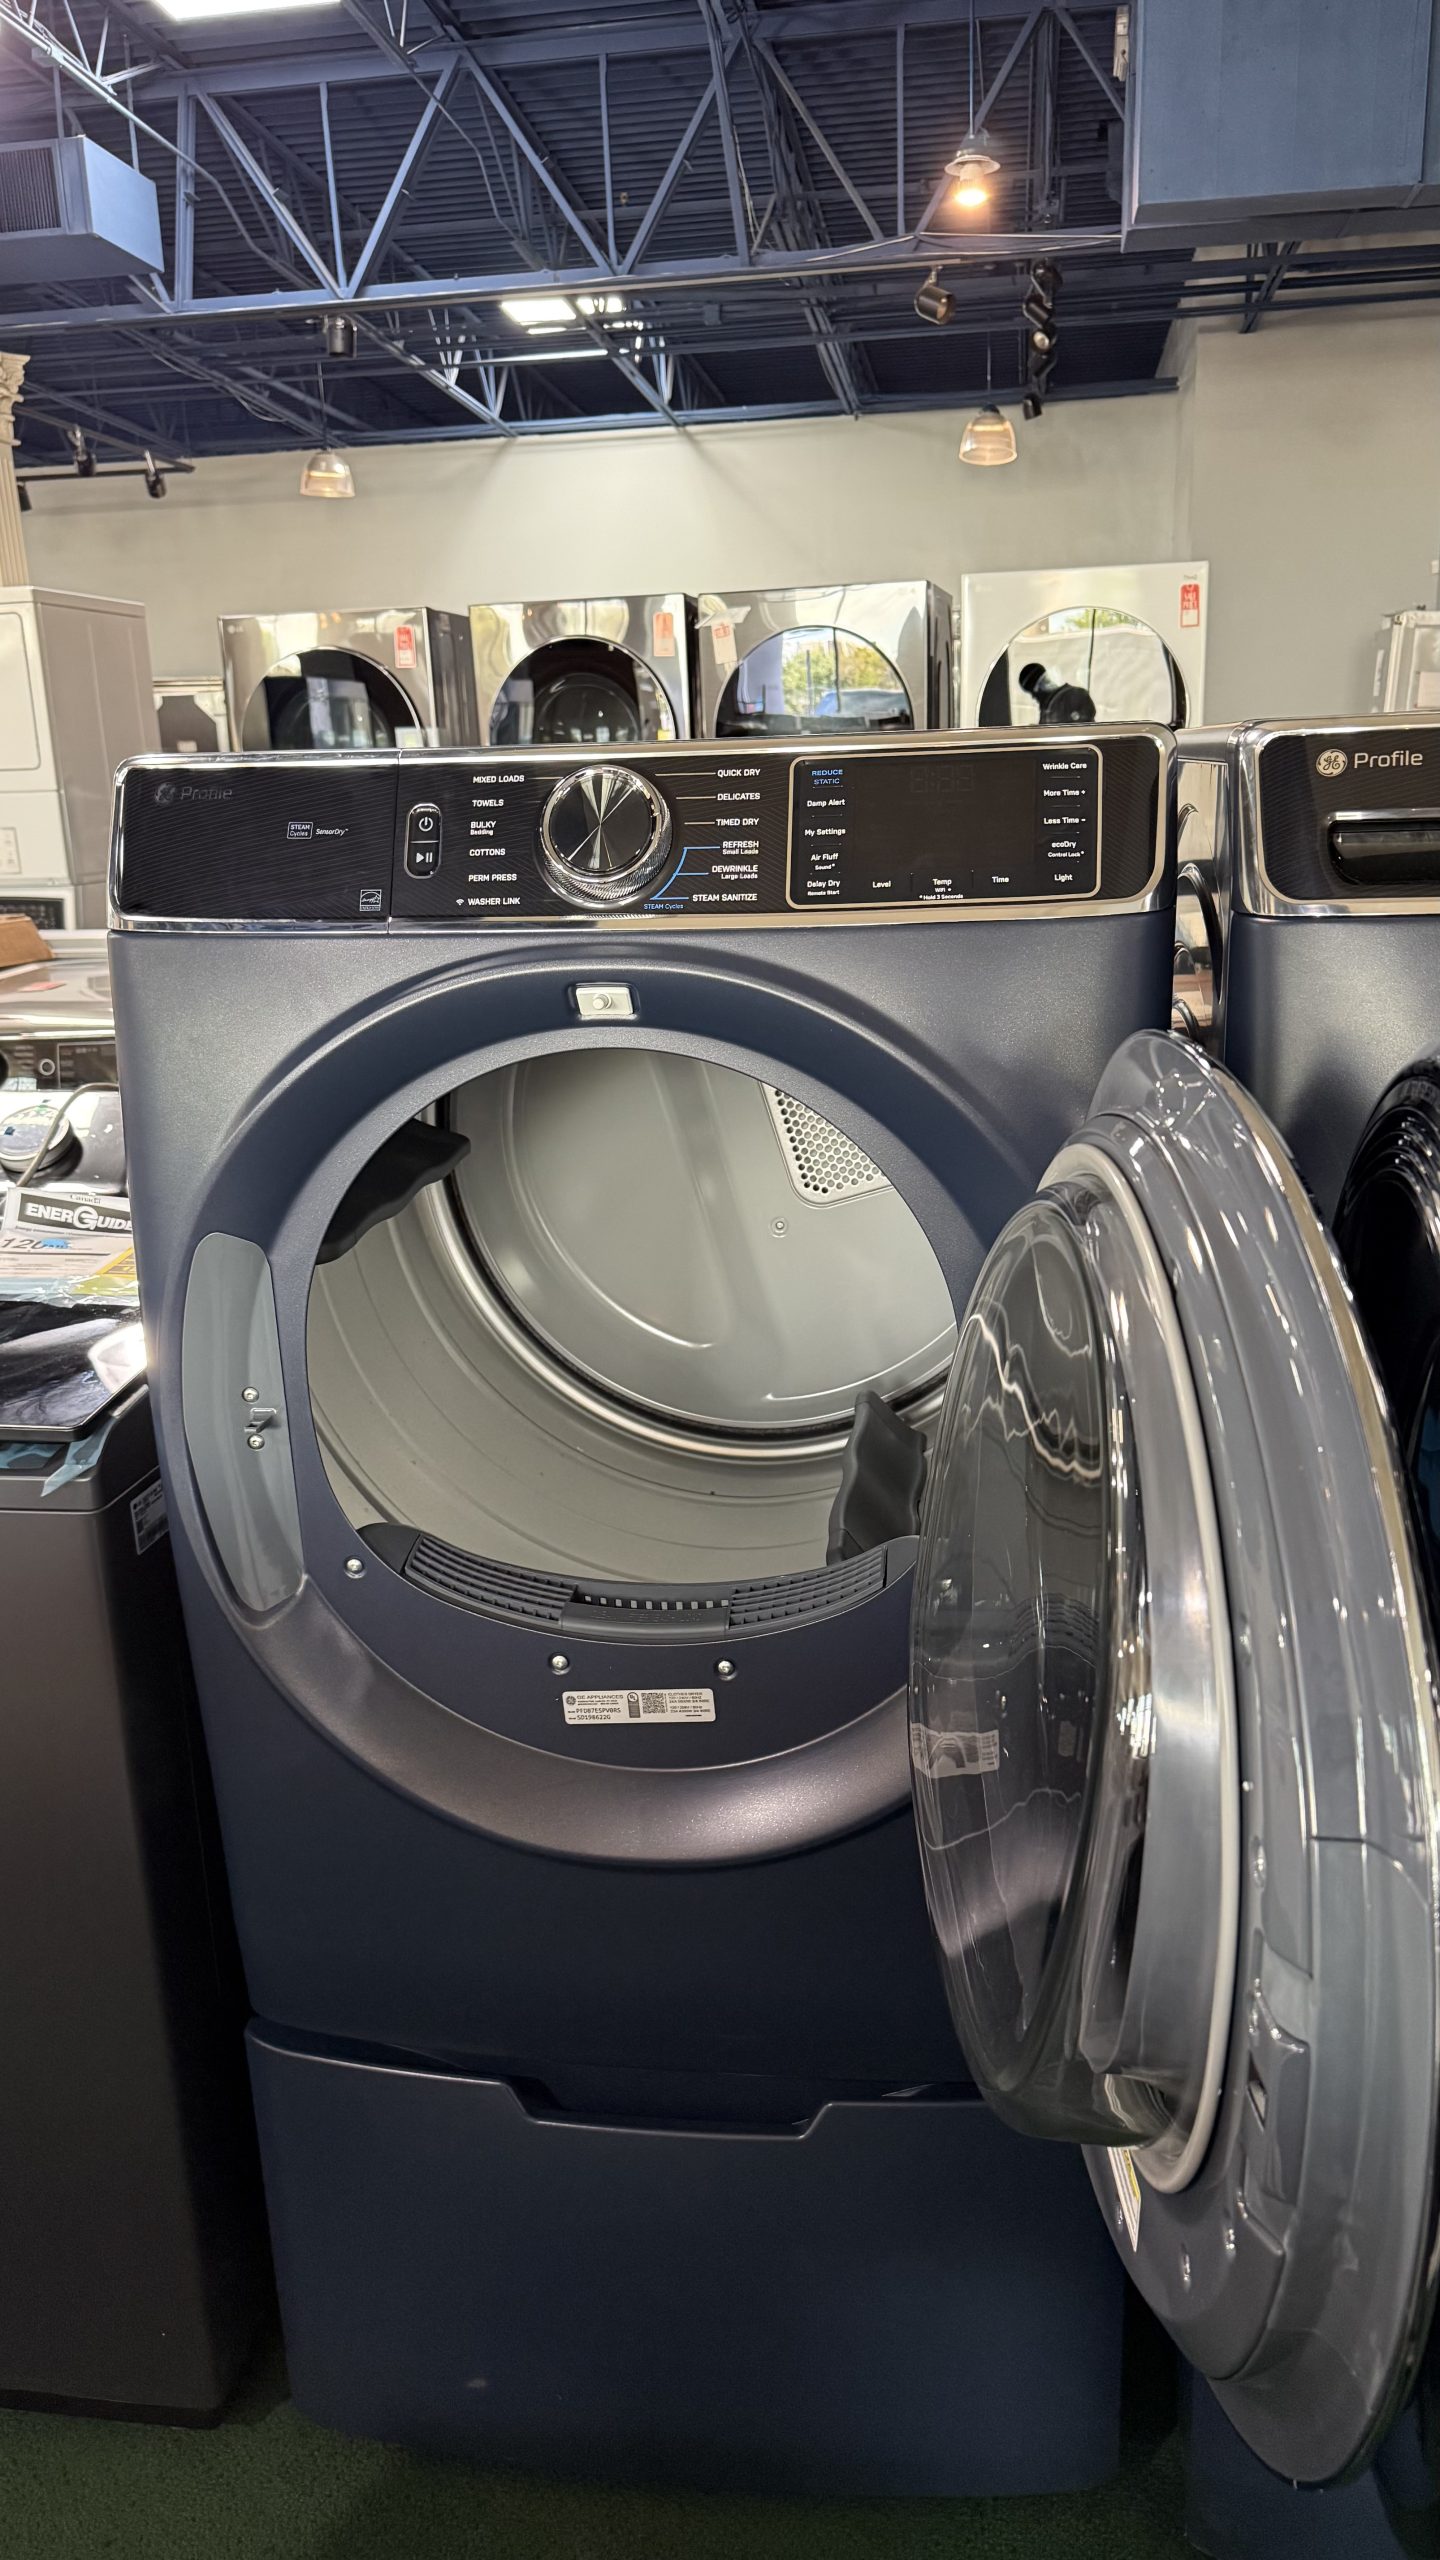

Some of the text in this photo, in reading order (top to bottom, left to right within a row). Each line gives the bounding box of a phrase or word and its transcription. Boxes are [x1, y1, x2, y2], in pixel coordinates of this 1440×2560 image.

[1354, 750, 1423, 769] Profile
[717, 768, 761, 777] QUICK DRY
[472, 774, 525, 784] MIXED LOADS
[717, 792, 761, 801] DELICATES
[1043, 789, 1061, 797] More
[471, 799, 505, 807] TOWELS
[828, 798, 846, 806] Alert
[470, 820, 497, 829] BULKY
[715, 817, 760, 827] TIMED DRY
[1043, 817, 1061, 825] Less
[1062, 816, 1080, 824] Time
[804, 827, 846, 837] My Settings
[722, 840, 760, 849] REFRESH
[1051, 840, 1077, 849] ecoDry
[469, 848, 506, 857] COTTONS
[810, 852, 840, 862] Air Fluff
[711, 864, 759, 873] DEWRINKLE
[468, 873, 518, 882] PERM PRESS
[991, 876, 1010, 884] Time
[1054, 873, 1073, 883] Light
[806, 879, 841, 889] Delay Dry
[872, 880, 892, 889] Level
[932, 878, 952, 887] Temp
[467, 897, 521, 906] WASHER LINK
[692, 893, 758, 903] STEAM SANITIZE
